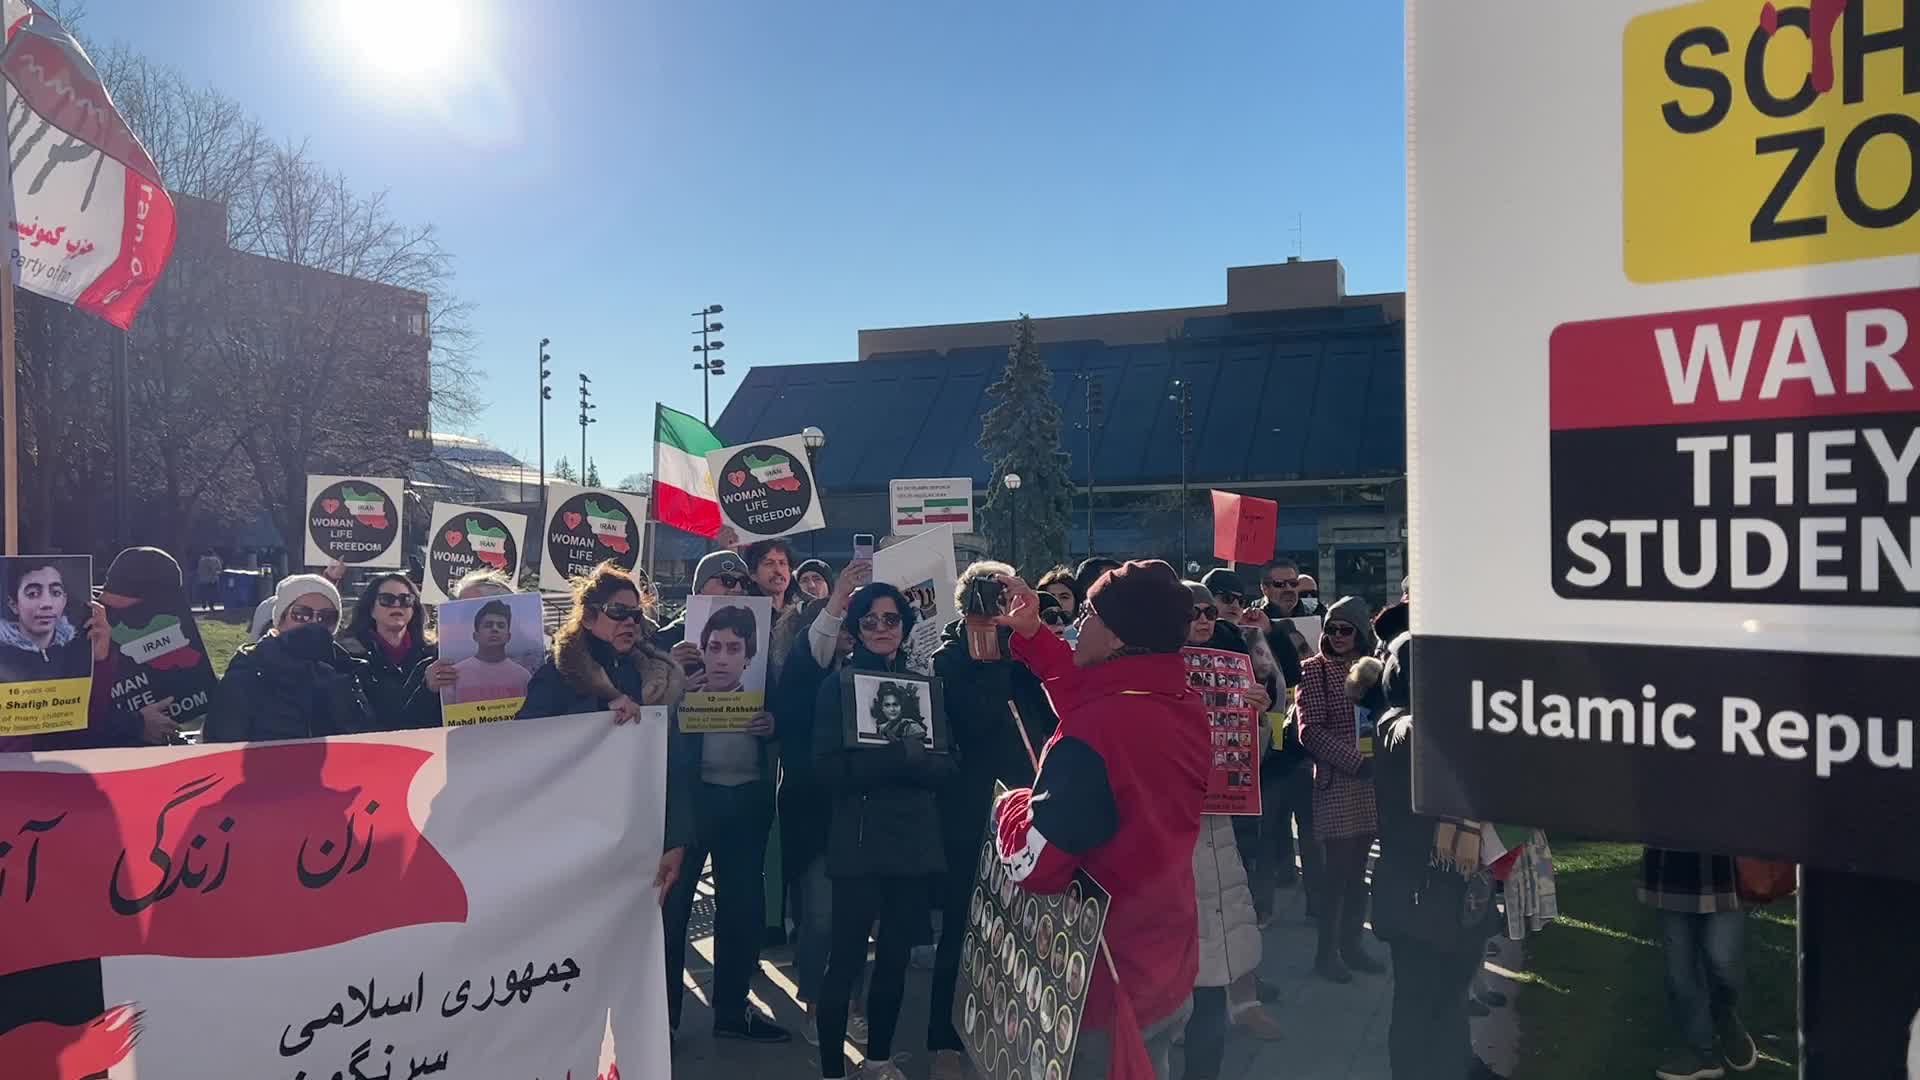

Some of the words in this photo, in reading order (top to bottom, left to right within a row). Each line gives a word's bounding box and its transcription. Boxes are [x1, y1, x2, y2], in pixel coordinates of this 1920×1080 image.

[1750, 113, 1920, 243] ZO
[1654, 308, 1914, 405] WAR
[1676, 428, 1920, 507] THEY
[722, 487, 767, 504] WOMAN
[745, 499, 769, 512] LIFE
[312, 517, 354, 528] WOMAN
[748, 506, 802, 525] FREEDOM
[330, 529, 353, 539] LIFE
[600, 522, 617, 532] IRAN
[329, 541, 382, 553] FREEDOM
[551, 533, 595, 549] WOMAN
[432, 550, 474, 565] WOMAN
[569, 549, 593, 561] LIFE
[1565, 516, 1920, 593] STUDEN
[143, 635, 171, 654] IRAN
[6, 699, 49, 710] Shafigh
[51, 696, 81, 706] Doust
[447, 717, 477, 727] Mahdi
[1471, 679, 1697, 750] Islamic
[1722, 696, 1914, 777] Repu
[109, 772, 234, 916] زندگی
[296, 800, 379, 888] زن
[441, 956, 581, 1018] جمهوری
[279, 972, 424, 1057] اسلامی
